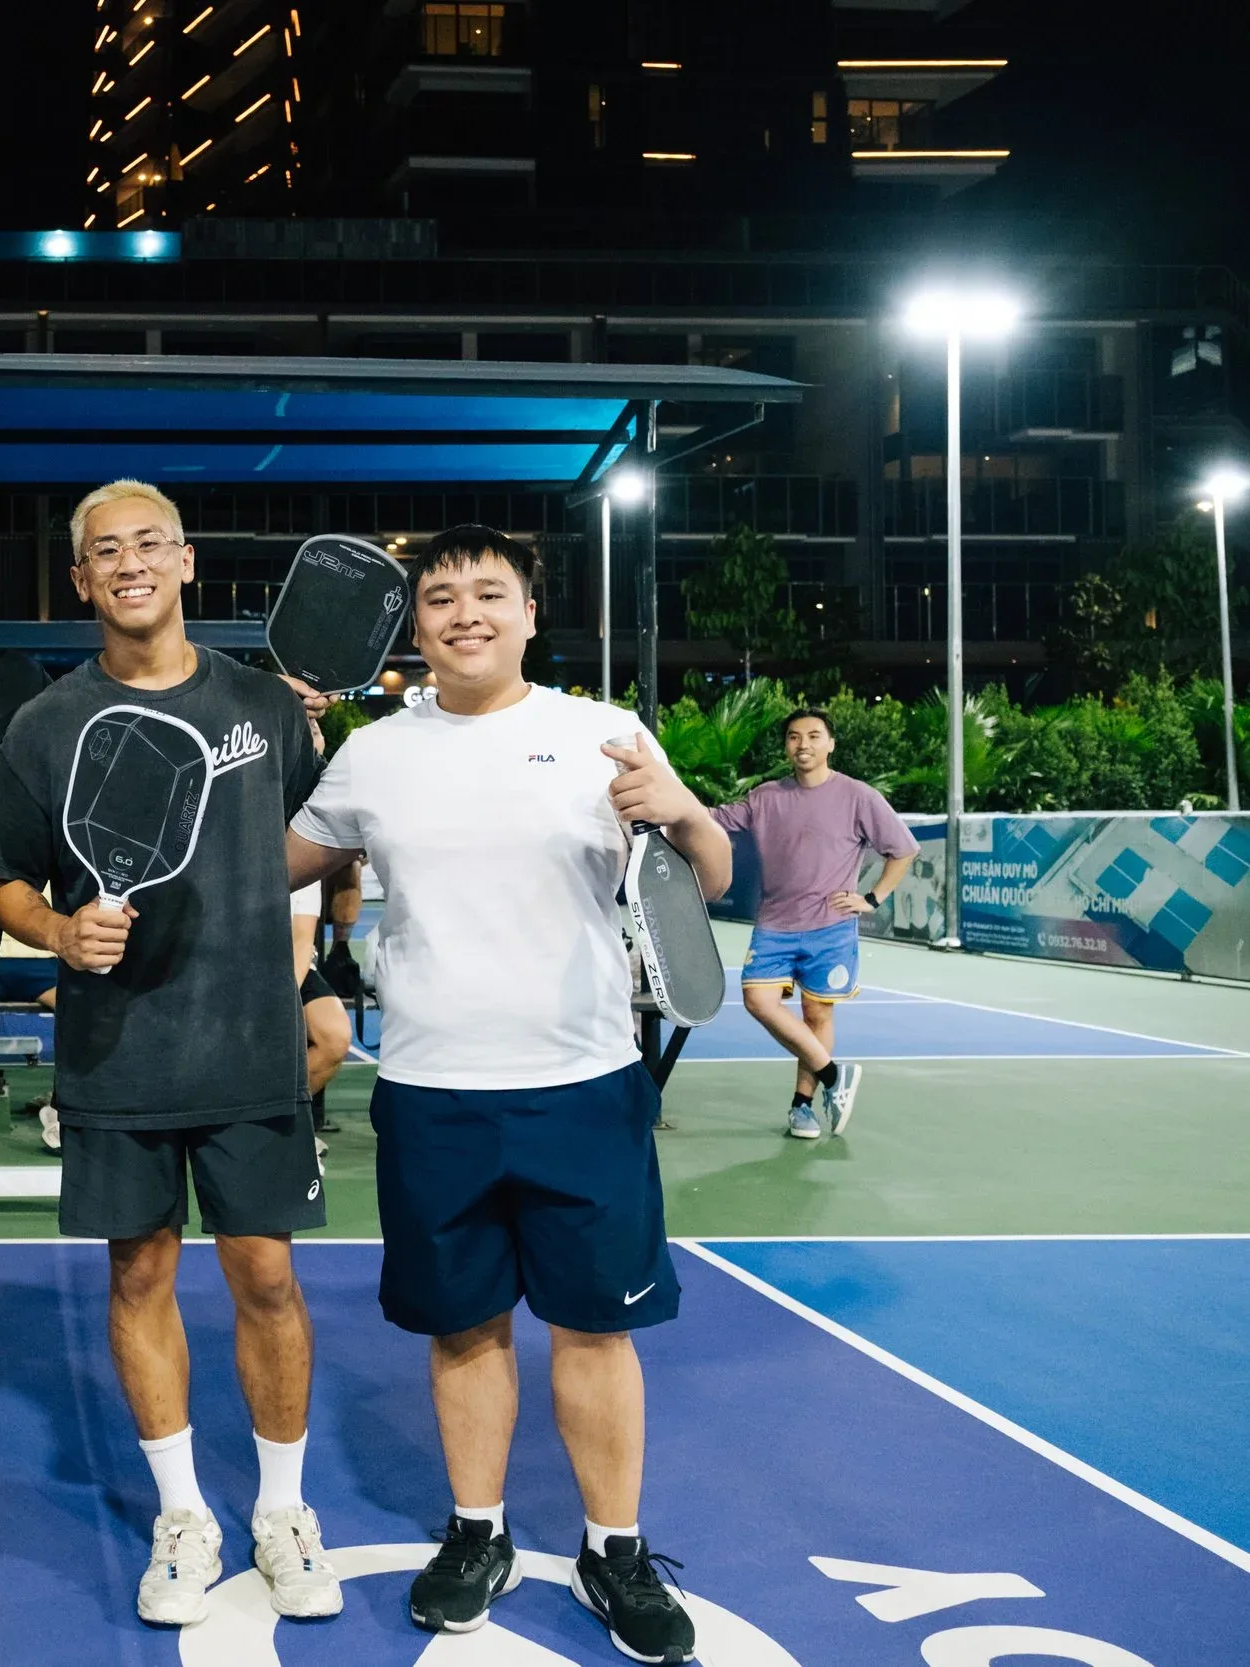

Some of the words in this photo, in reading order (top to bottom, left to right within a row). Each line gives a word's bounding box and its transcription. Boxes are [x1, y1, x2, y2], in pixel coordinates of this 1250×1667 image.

[528, 754, 555, 763] FILA
[174, 790, 200, 854] QUARTZ
[115, 855, 133, 867] 6.0
[630, 902, 645, 933] SIX
[642, 896, 672, 984] DIAMOND
